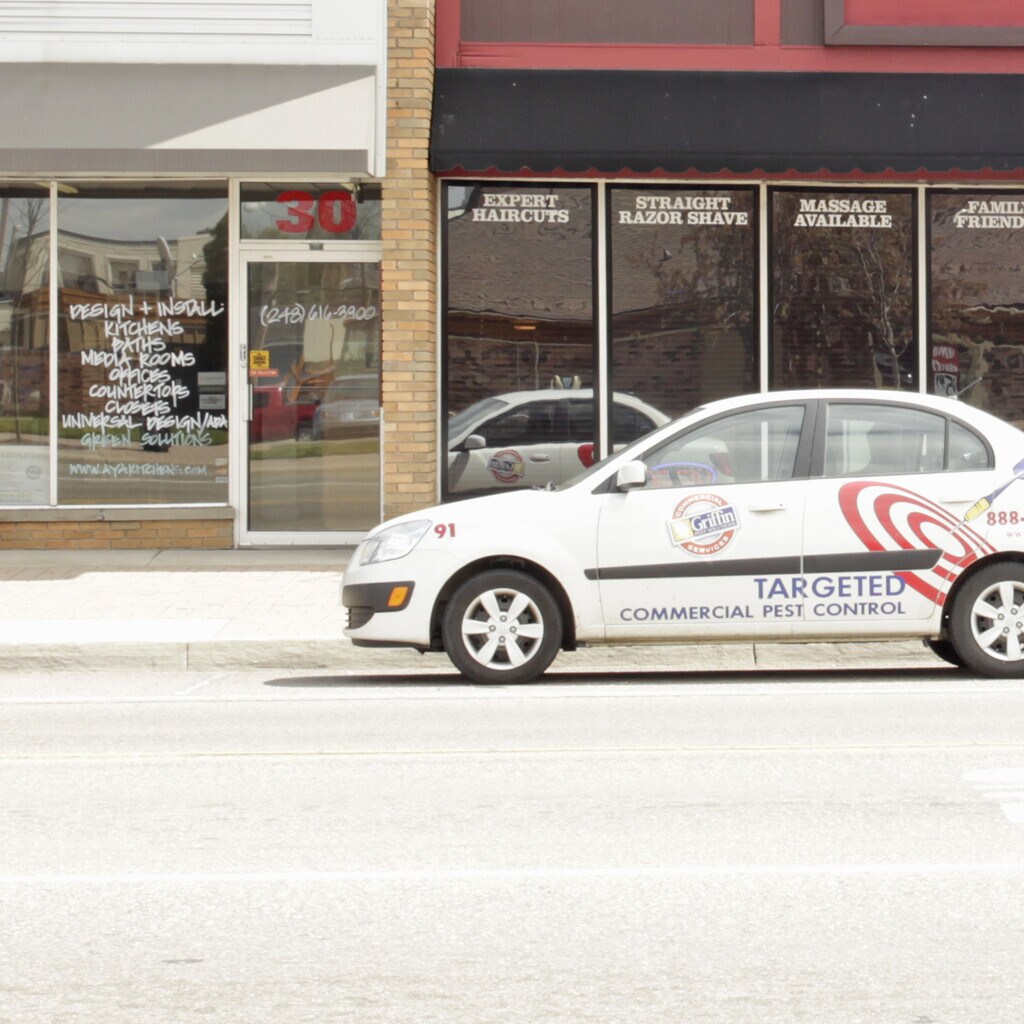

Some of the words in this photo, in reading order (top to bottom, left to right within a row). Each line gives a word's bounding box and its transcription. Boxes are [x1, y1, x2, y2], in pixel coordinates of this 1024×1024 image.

[483, 193, 558, 208] EXPERT
[635, 196, 731, 211] STRAIGHT
[800, 199, 887, 213] MASSAGE
[275, 189, 357, 234] 30
[472, 209, 570, 223] HAIRCUTS
[618, 210, 683, 225] RAZOR
[686, 212, 748, 226] SHAVE
[794, 214, 893, 228] AVAILABLE
[70, 294, 134, 323] DESIGN
[260, 302, 306, 327] (248)
[307, 304, 377, 322] 616-3900
[104, 318, 184, 337] KITCHENS
[111, 335, 167, 353] BATHS
[81, 349, 133, 368] MEDIA
[140, 350, 196, 368] ROOMS
[109, 366, 171, 386] OFFICES
[89, 380, 190, 407] COUNTERTOPS
[105, 399, 171, 416] CLOSETS
[62, 412, 143, 436] UNIVERSAL
[80, 431, 132, 452] GREEN
[140, 429, 213, 448] SOLUTIONS
[675, 495, 722, 517] COMMERCIAL
[690, 510, 735, 532] Griffin
[434, 523, 456, 539] 91
[687, 535, 729, 553] SERVICES
[754, 575, 906, 600] TARGETED
[620, 606, 754, 621] COMMERCIAL
[763, 604, 804, 618] PEST
[813, 602, 906, 617] CONTROL
